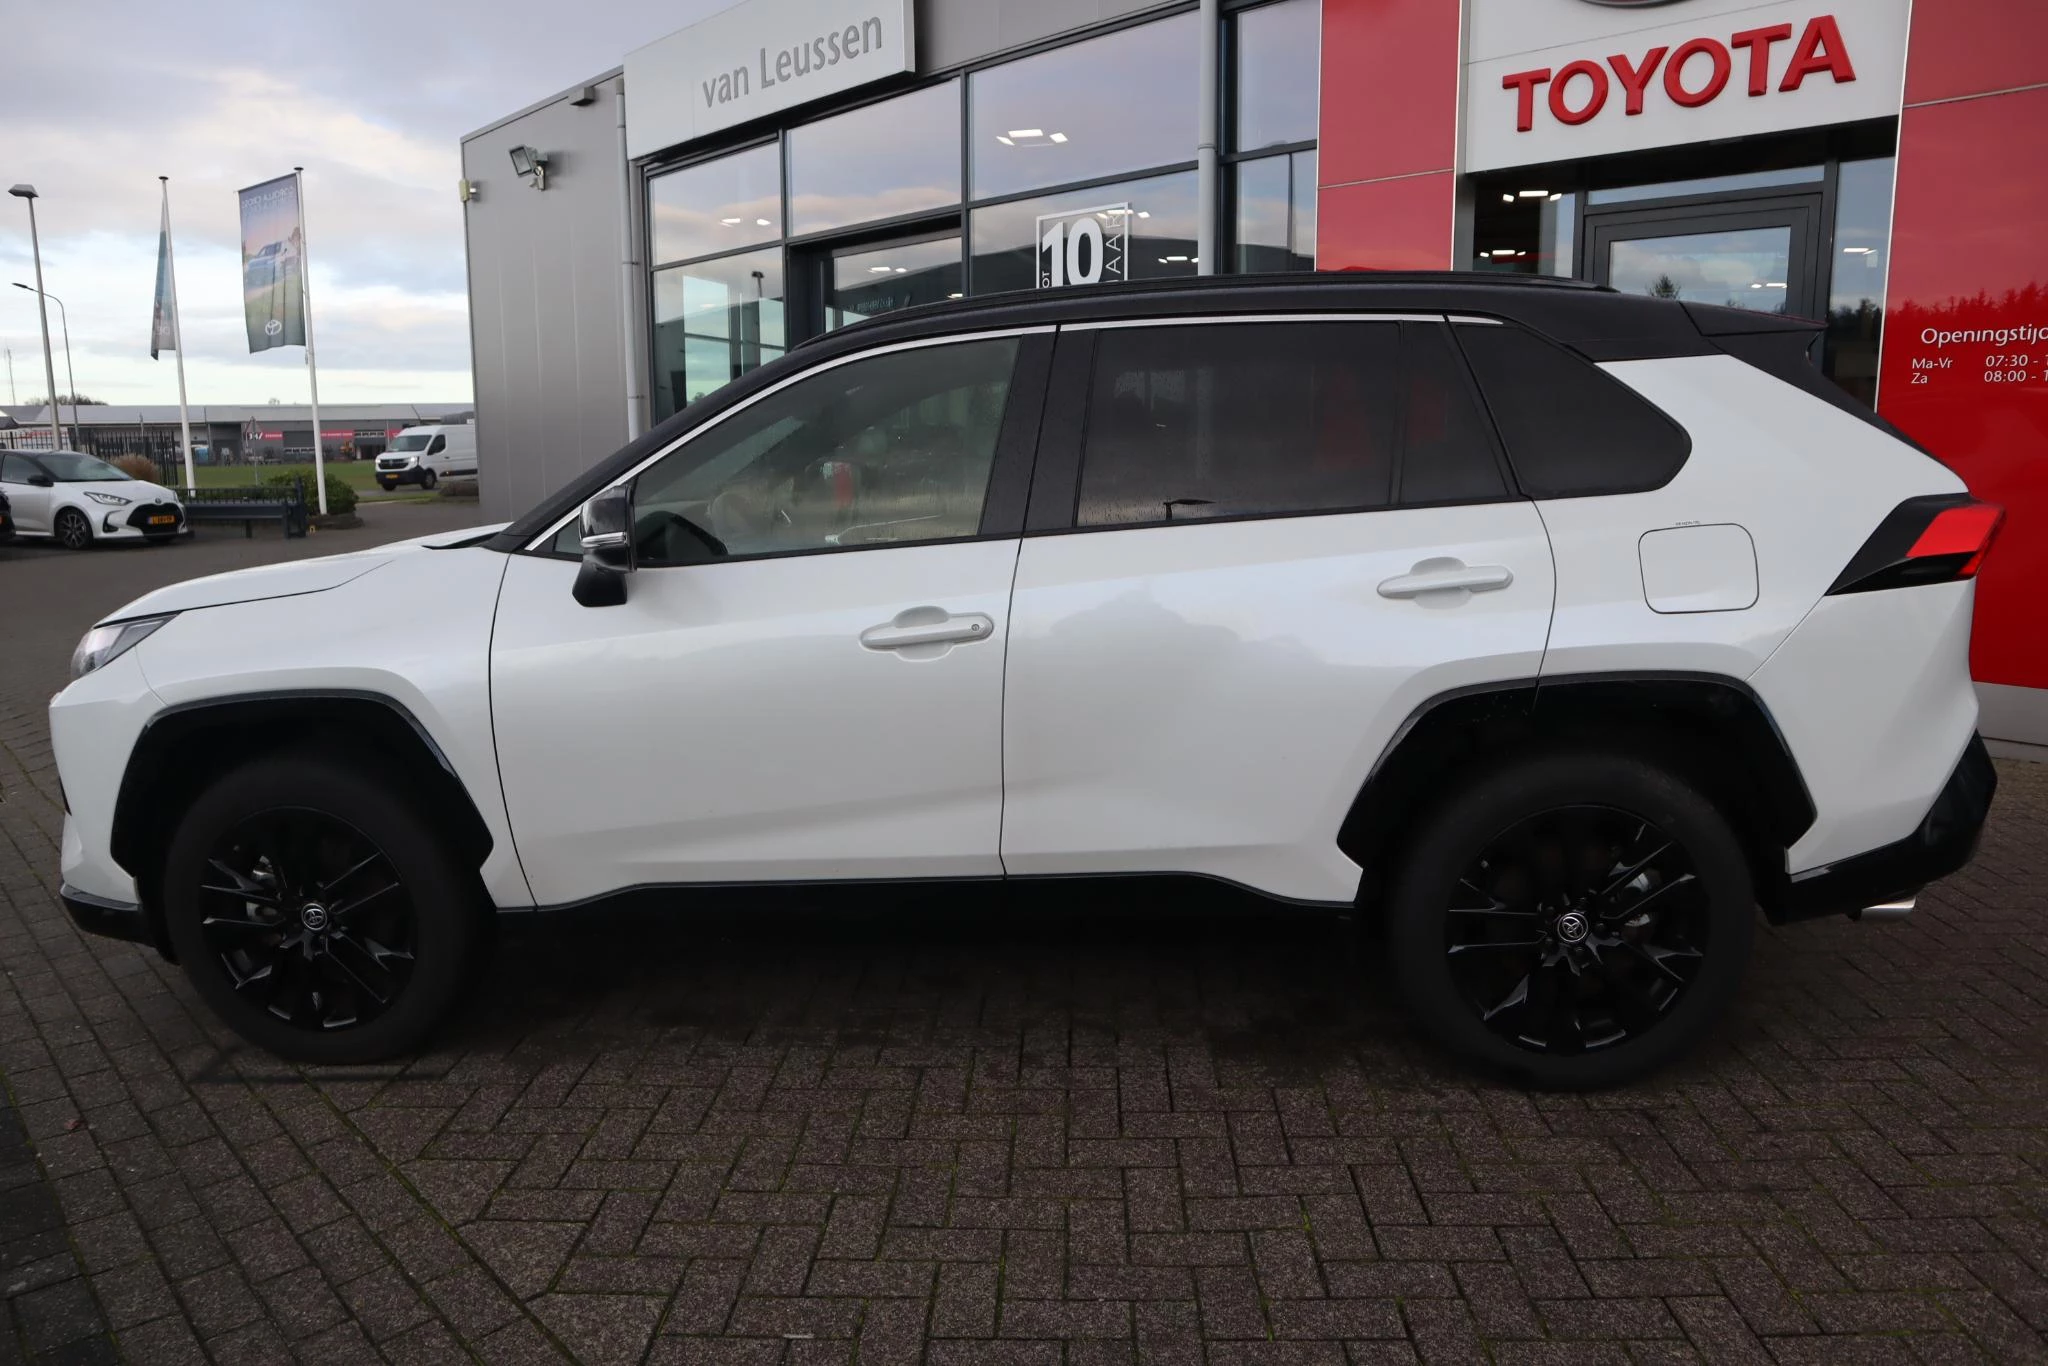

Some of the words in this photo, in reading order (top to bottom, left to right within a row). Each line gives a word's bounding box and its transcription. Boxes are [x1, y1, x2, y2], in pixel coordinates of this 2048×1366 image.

[703, 66, 749, 108] van
[760, 16, 882, 89] Leussen
[1503, 15, 1856, 132] TOYOTA
[1042, 217, 1103, 287] 10
[1042, 270, 1050, 288] OT
[1105, 214, 1121, 283] AAR
[1911, 357, 1953, 369] Ma-Vr
[1985, 354, 2028, 367] 07:30
[1911, 372, 1928, 384] Za
[1983, 370, 2027, 382] 08:00
